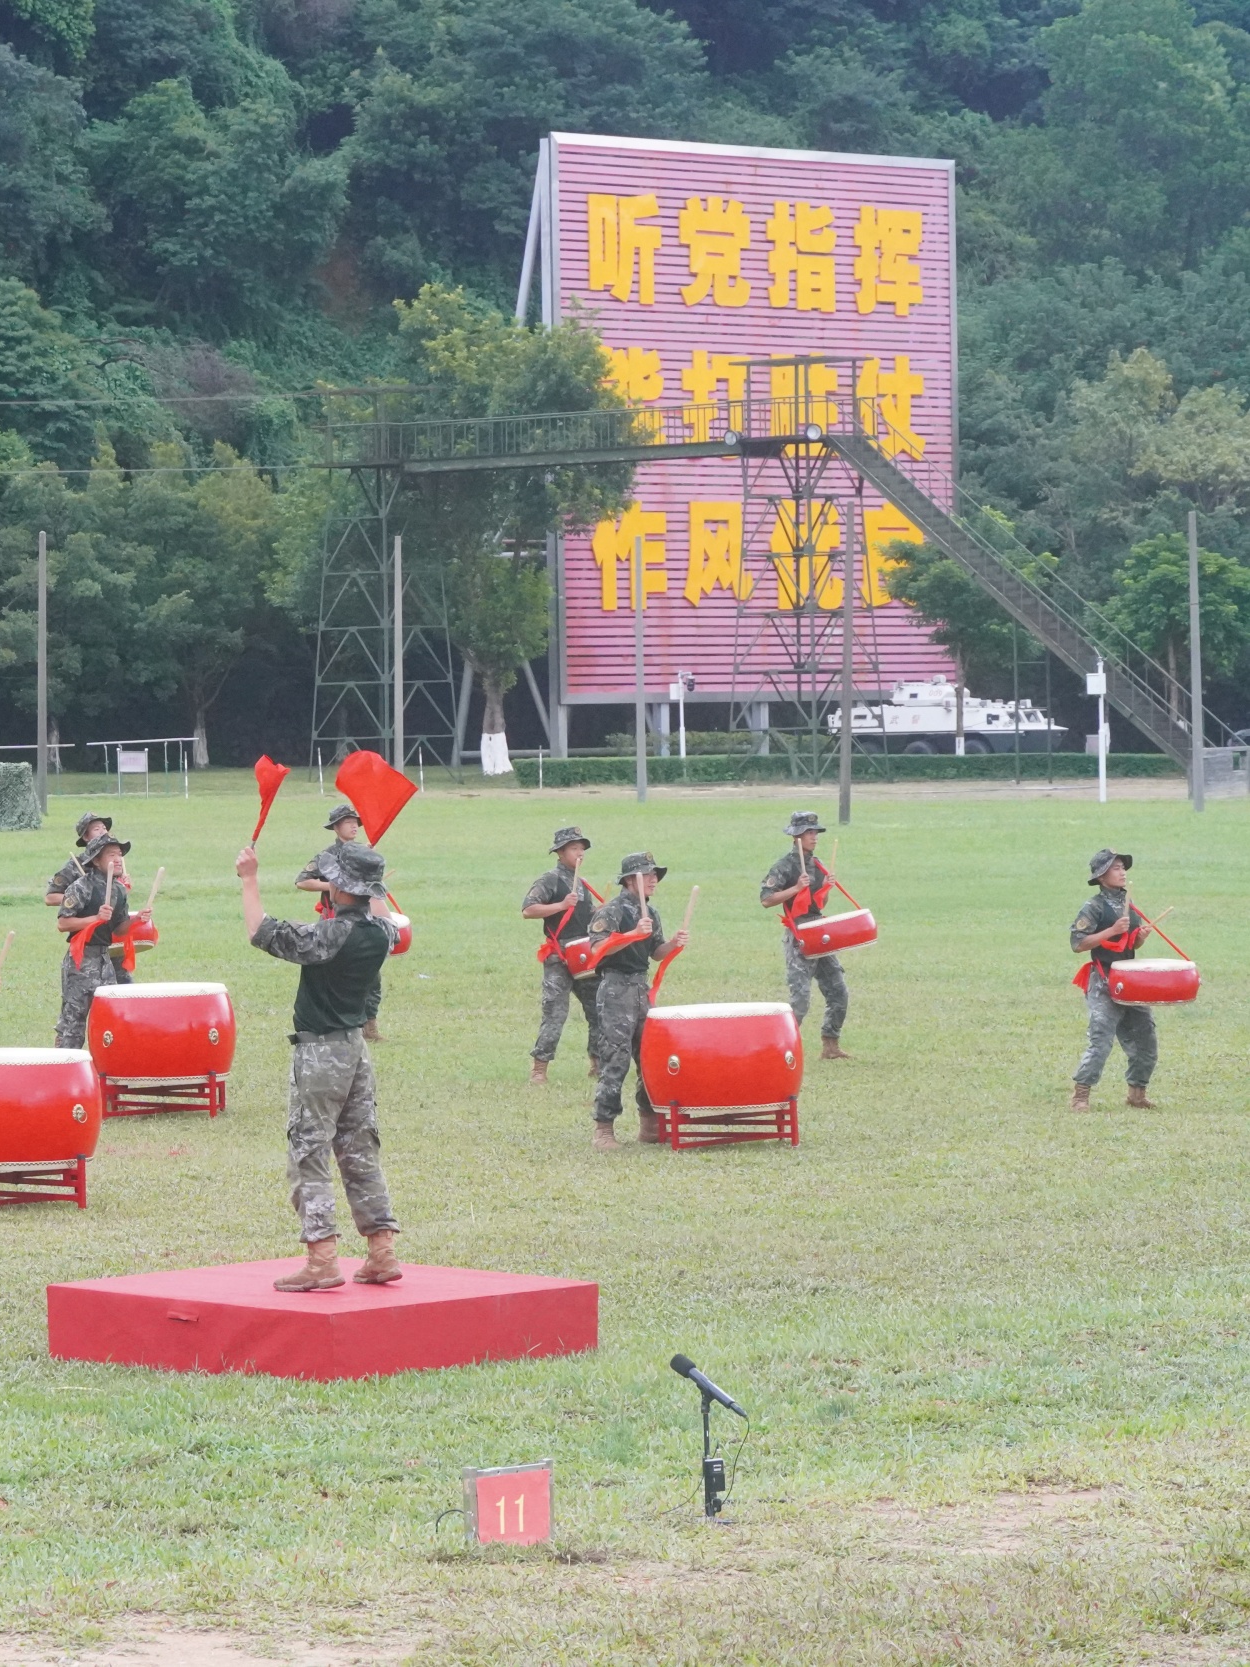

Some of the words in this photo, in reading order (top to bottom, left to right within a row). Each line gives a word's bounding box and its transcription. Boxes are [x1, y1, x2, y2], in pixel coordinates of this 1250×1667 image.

[587, 193, 924, 317] 听党指挥
[495, 1493, 525, 1535] 11
